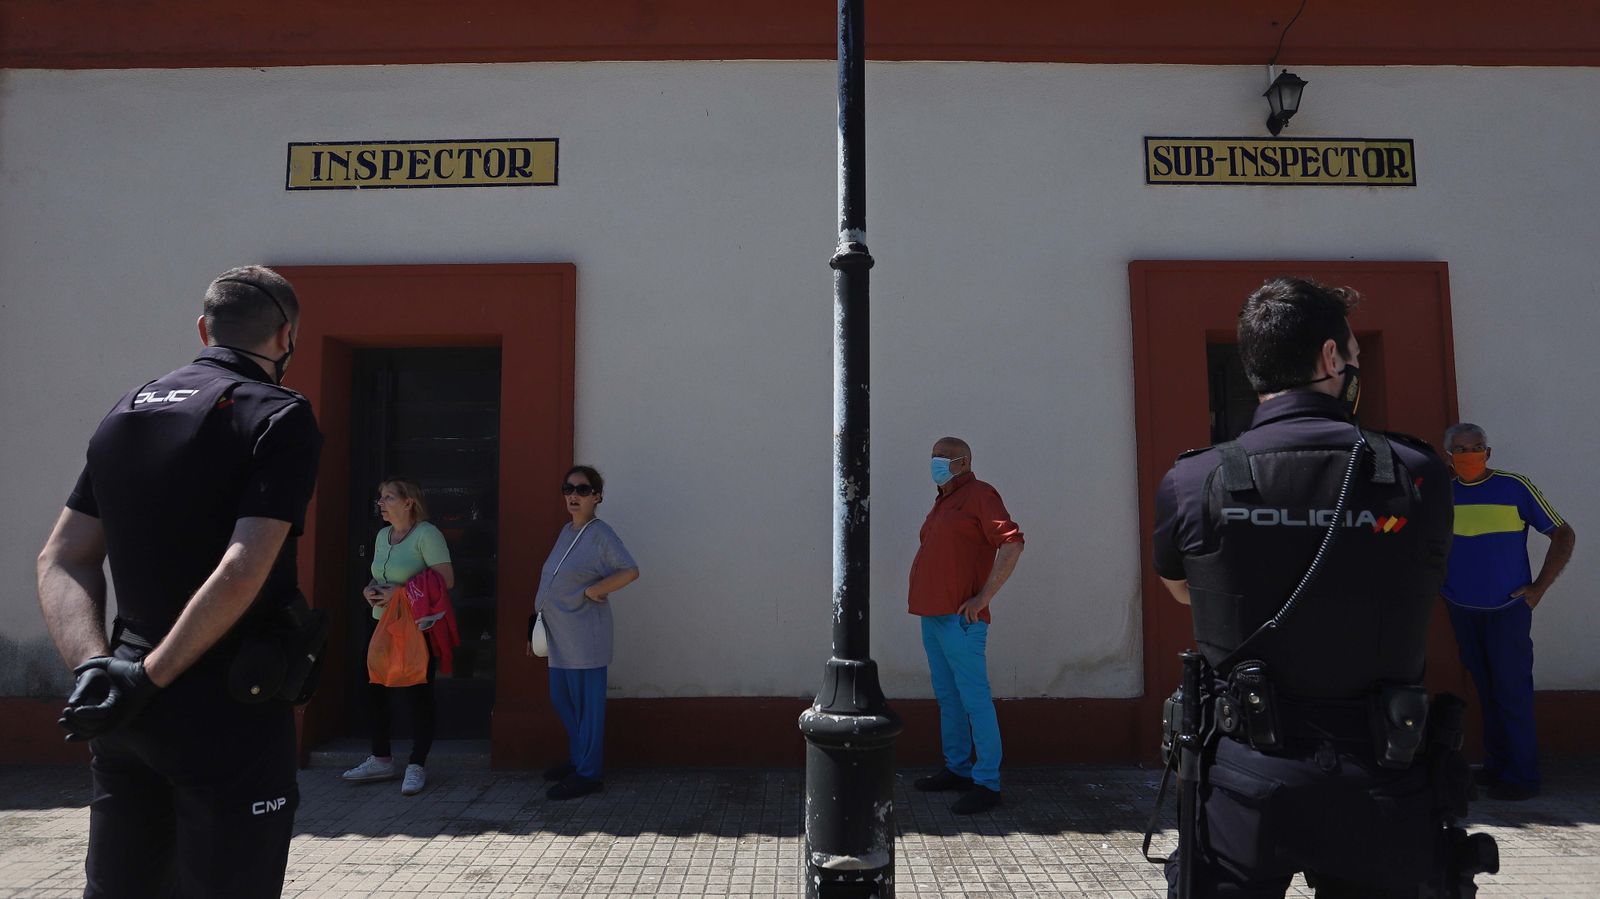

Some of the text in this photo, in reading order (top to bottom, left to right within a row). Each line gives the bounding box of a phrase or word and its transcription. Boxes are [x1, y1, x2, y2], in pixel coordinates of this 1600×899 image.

[310, 147, 533, 181] INSPECTOR
[1153, 145, 1409, 178] SUB-INSPECTOR
[1221, 507, 1378, 528] POLICIA
[252, 796, 287, 815] CNP
